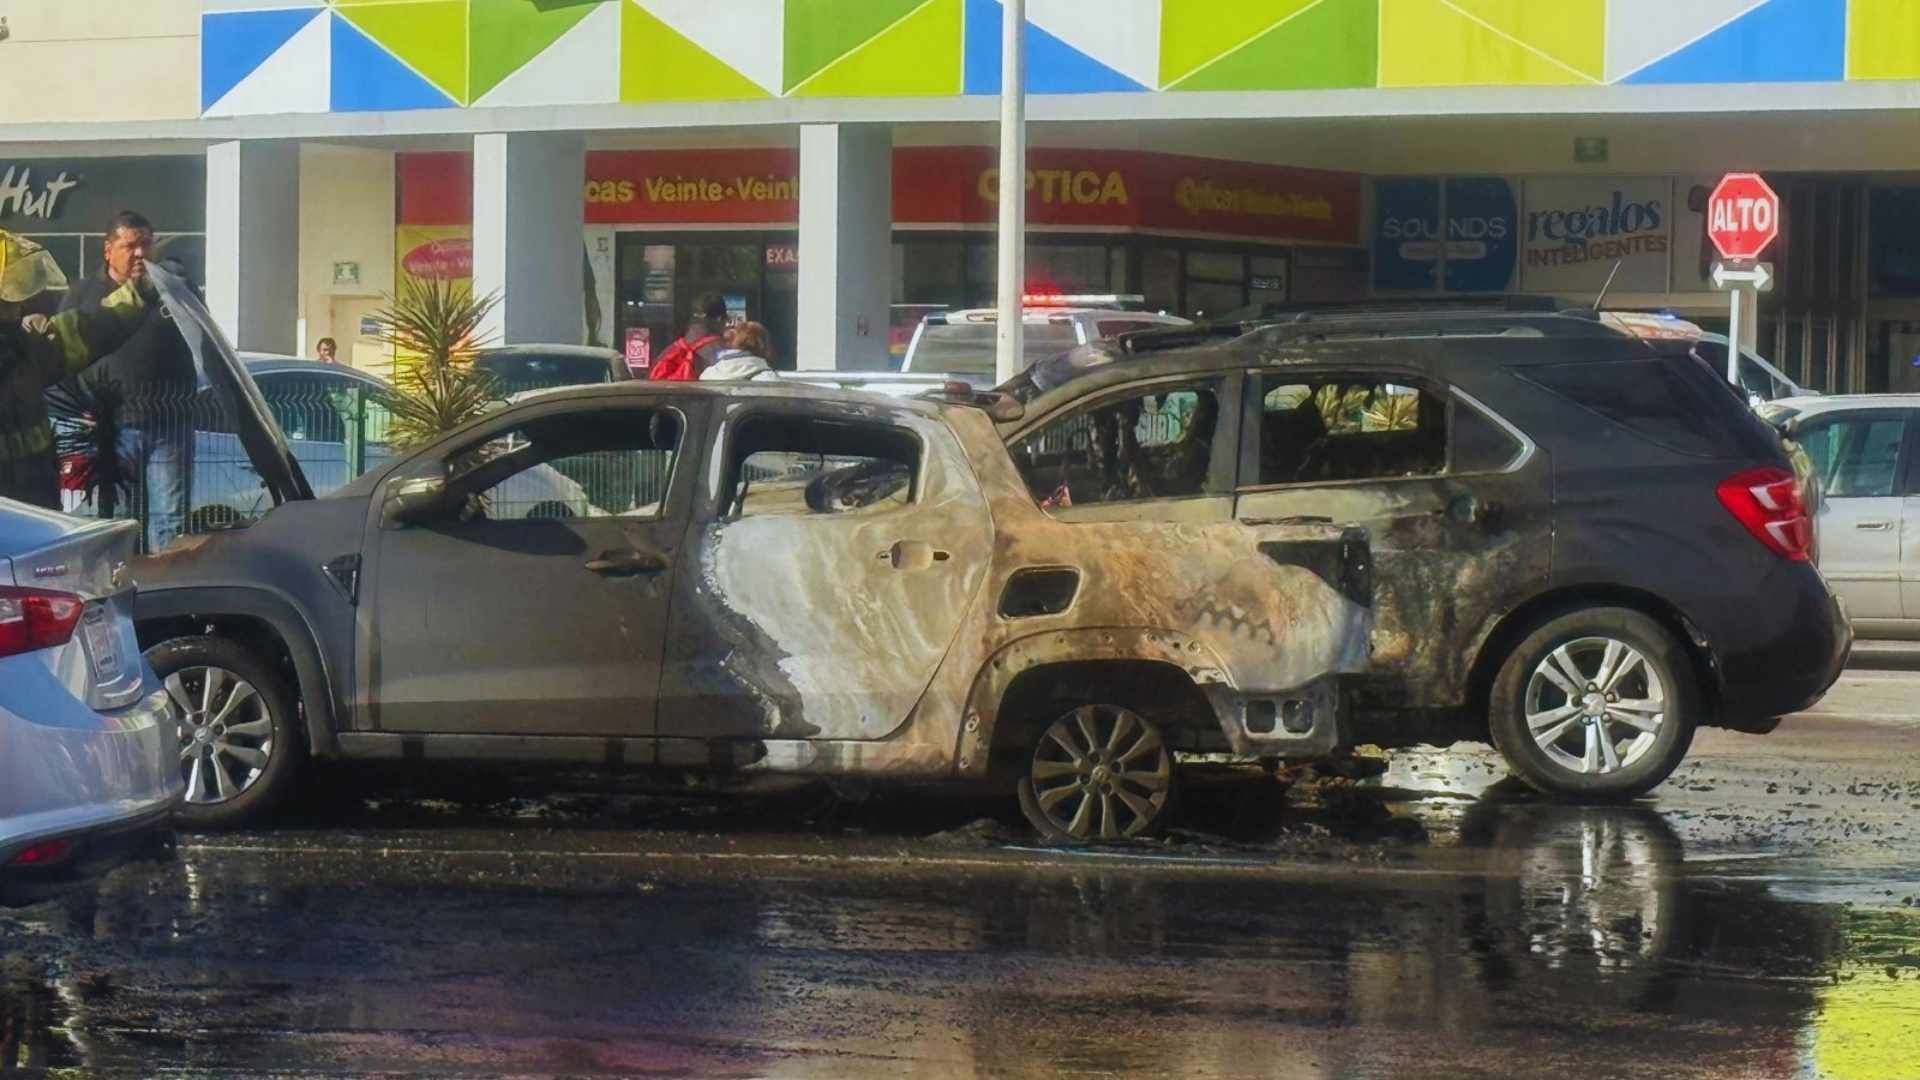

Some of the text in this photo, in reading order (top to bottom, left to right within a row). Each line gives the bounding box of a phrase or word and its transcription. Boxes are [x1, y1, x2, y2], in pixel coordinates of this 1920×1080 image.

[0, 166, 77, 218] Hut
[1383, 216, 1506, 239] SOUNDS
[1528, 190, 1661, 246] regalos
[1712, 197, 1771, 232] ALTO
[767, 247, 799, 264] EXA
